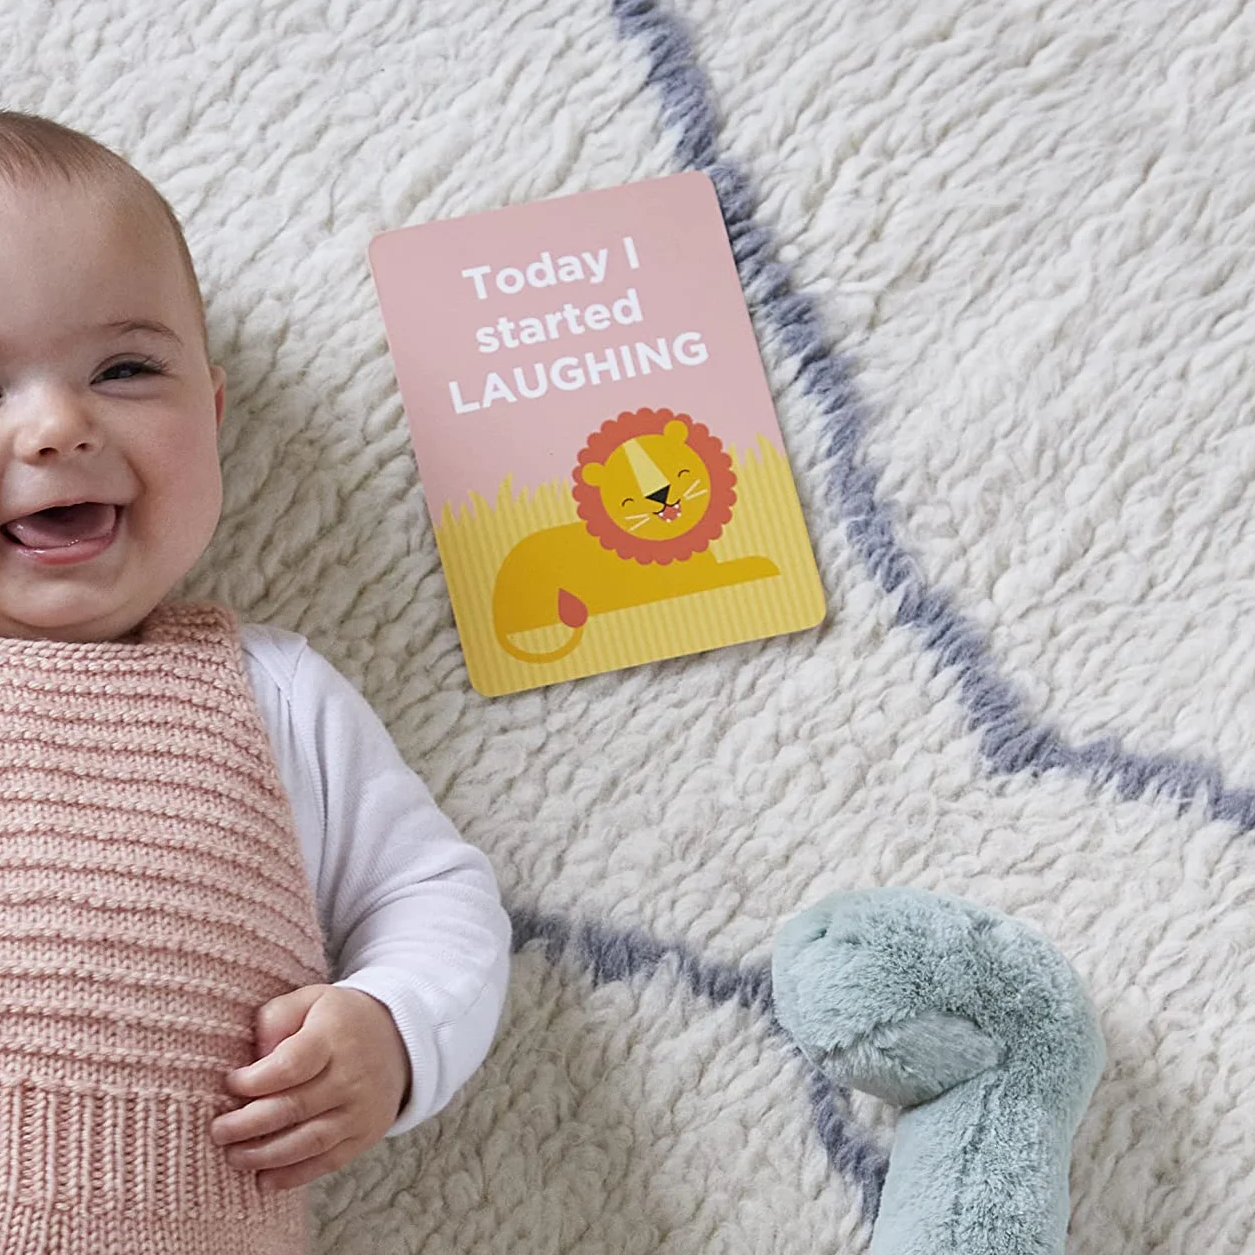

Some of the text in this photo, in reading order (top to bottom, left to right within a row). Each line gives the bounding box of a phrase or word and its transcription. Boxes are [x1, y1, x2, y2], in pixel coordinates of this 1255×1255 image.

[461, 236, 640, 300] Today I
[475, 288, 644, 354] started
[448, 331, 710, 415] LAUGHING
